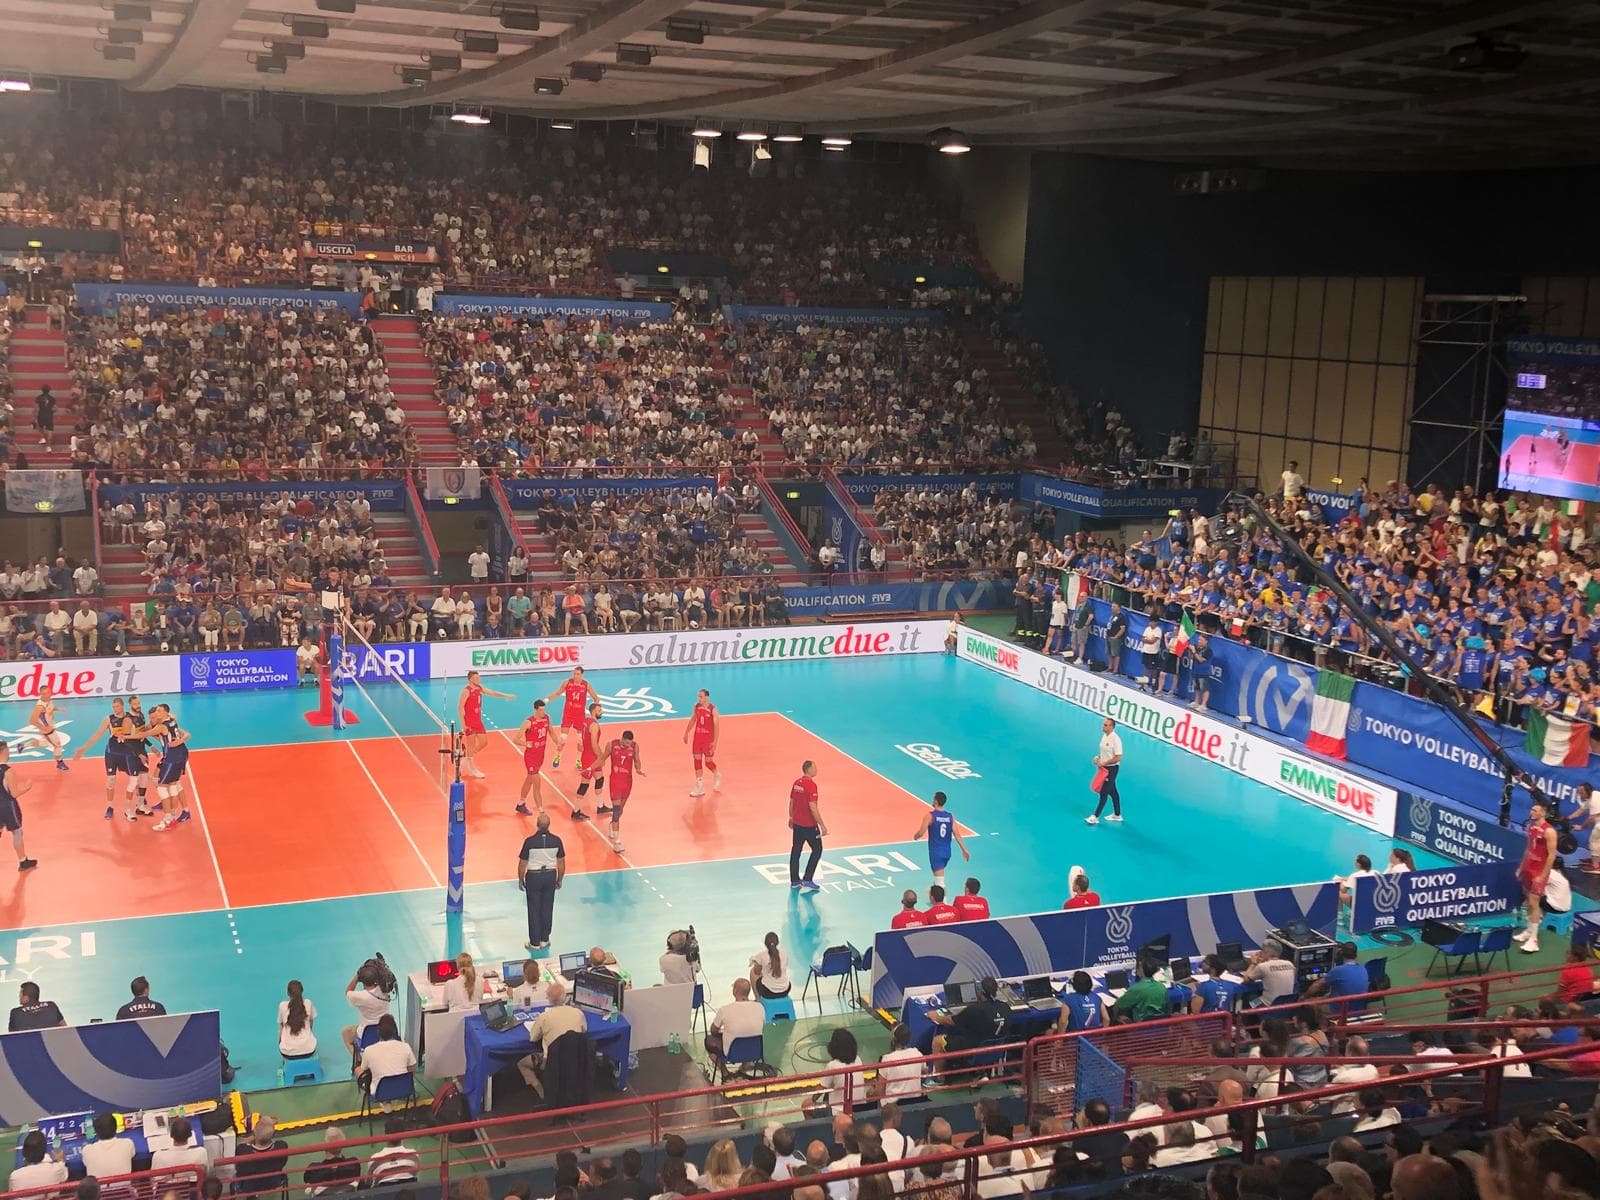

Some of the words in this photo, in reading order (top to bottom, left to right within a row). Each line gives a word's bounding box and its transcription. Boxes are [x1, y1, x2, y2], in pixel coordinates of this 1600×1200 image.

[319, 245, 353, 254] USCITA
[394, 245, 413, 253] BAR
[557, 307, 629, 318] QUALFICATION
[372, 489, 394, 498] FIVB
[1041, 487, 1062, 499] TOKYO
[1062, 491, 1101, 507] VOLLEYBALL
[1101, 497, 1175, 508] QUALIFICATION
[871, 593, 891, 602] FIVB
[629, 624, 922, 666] salumiemmedue.it
[472, 645, 580, 667] EMMEDUE
[966, 636, 1020, 671] EMMEDUE
[215, 658, 249, 667] TOKYO
[341, 648, 415, 678] BARI
[215, 665, 274, 676] VOLLEYBALL
[215, 673, 288, 685] QUALIFICATION
[572, 692, 580, 701] 14
[1037, 666, 1250, 772] salumiemmedue.it
[1365, 716, 1413, 745] TOKYO
[620, 755, 626, 765] 7
[1280, 758, 1375, 817] EMMEDUE
[1438, 809, 1477, 833] TOKYO
[940, 823, 947, 838] 6
[1436, 823, 1504, 860] VOLLEYBALL
[1434, 838, 1497, 865] QUALIFIC
[752, 851, 922, 885] BARI
[819, 876, 896, 894] ITALY
[1410, 873, 1456, 890] TOKYO
[1408, 885, 1489, 905] VOLLEYBALL
[1406, 898, 1507, 922] QUALIFICATION
[1375, 916, 1396, 926] FIVB
[1098, 952, 1137, 962] VOLLEYBALL
[1107, 945, 1129, 954] TOKYO
[21, 1001, 49, 1013] ITALIA
[129, 1002, 156, 1013] ITALIA
[58, 1121, 65, 1130] 2
[69, 1119, 75, 1128] 2
